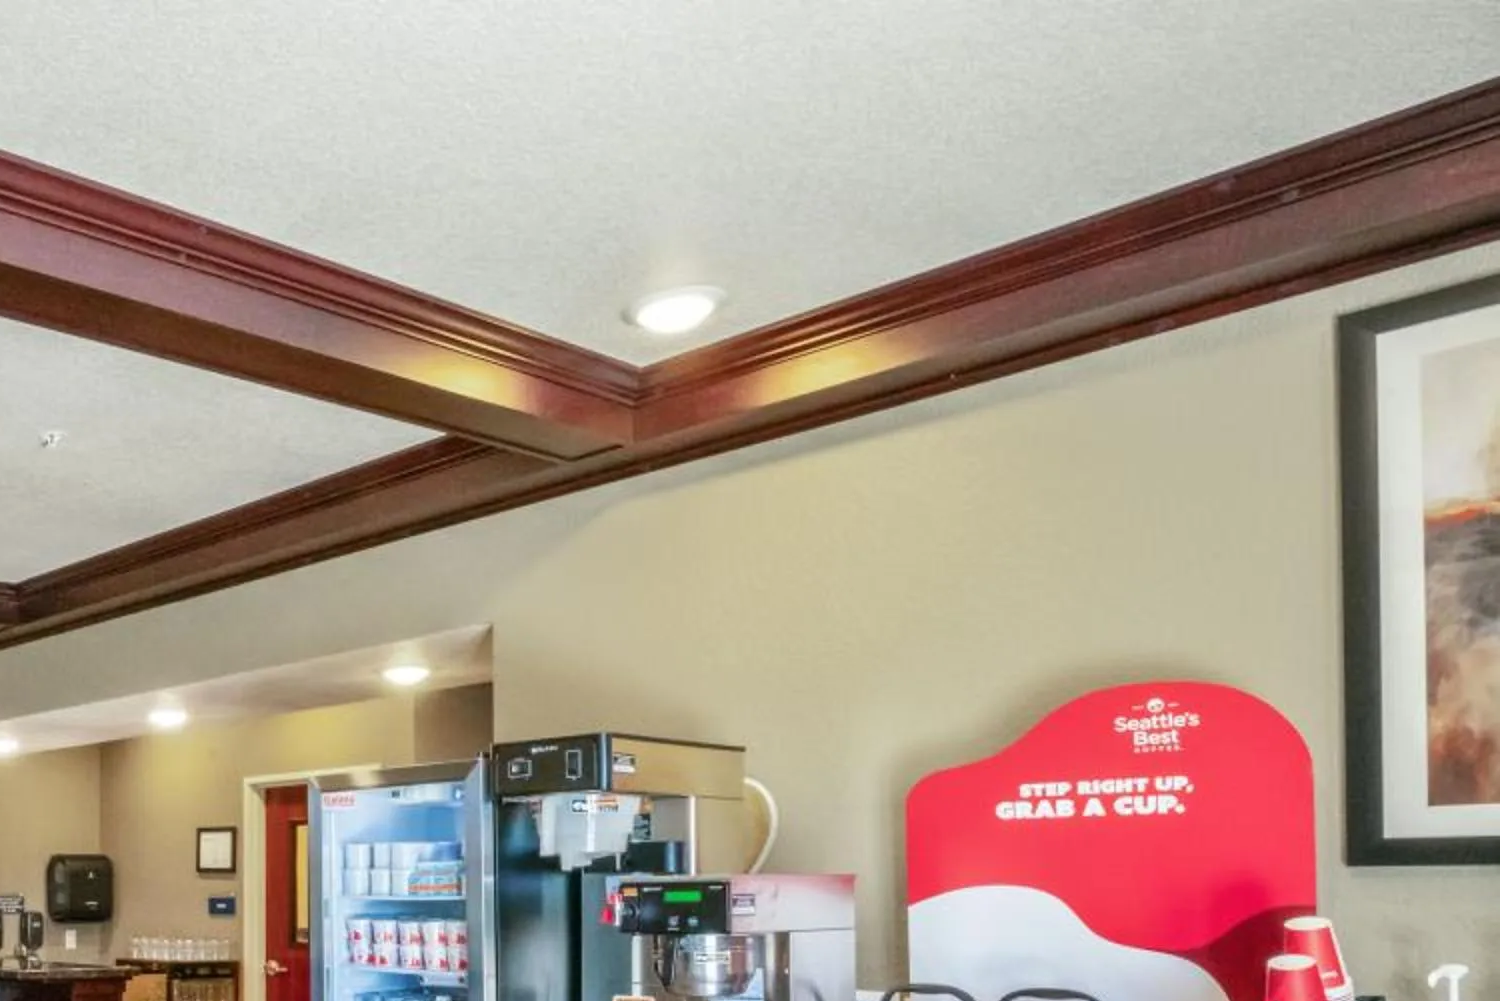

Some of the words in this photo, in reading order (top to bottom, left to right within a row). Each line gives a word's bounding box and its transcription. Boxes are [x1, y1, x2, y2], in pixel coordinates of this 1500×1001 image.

[1113, 712, 1200, 732] Seattle's
[1133, 729, 1180, 746] Best
[1019, 782, 1072, 798] STEP
[1077, 778, 1149, 795] RIGHT
[1155, 776, 1194, 793] UP,
[995, 800, 1075, 820] GRAB
[1082, 796, 1107, 818] A
[1113, 794, 1187, 816] CUP.
